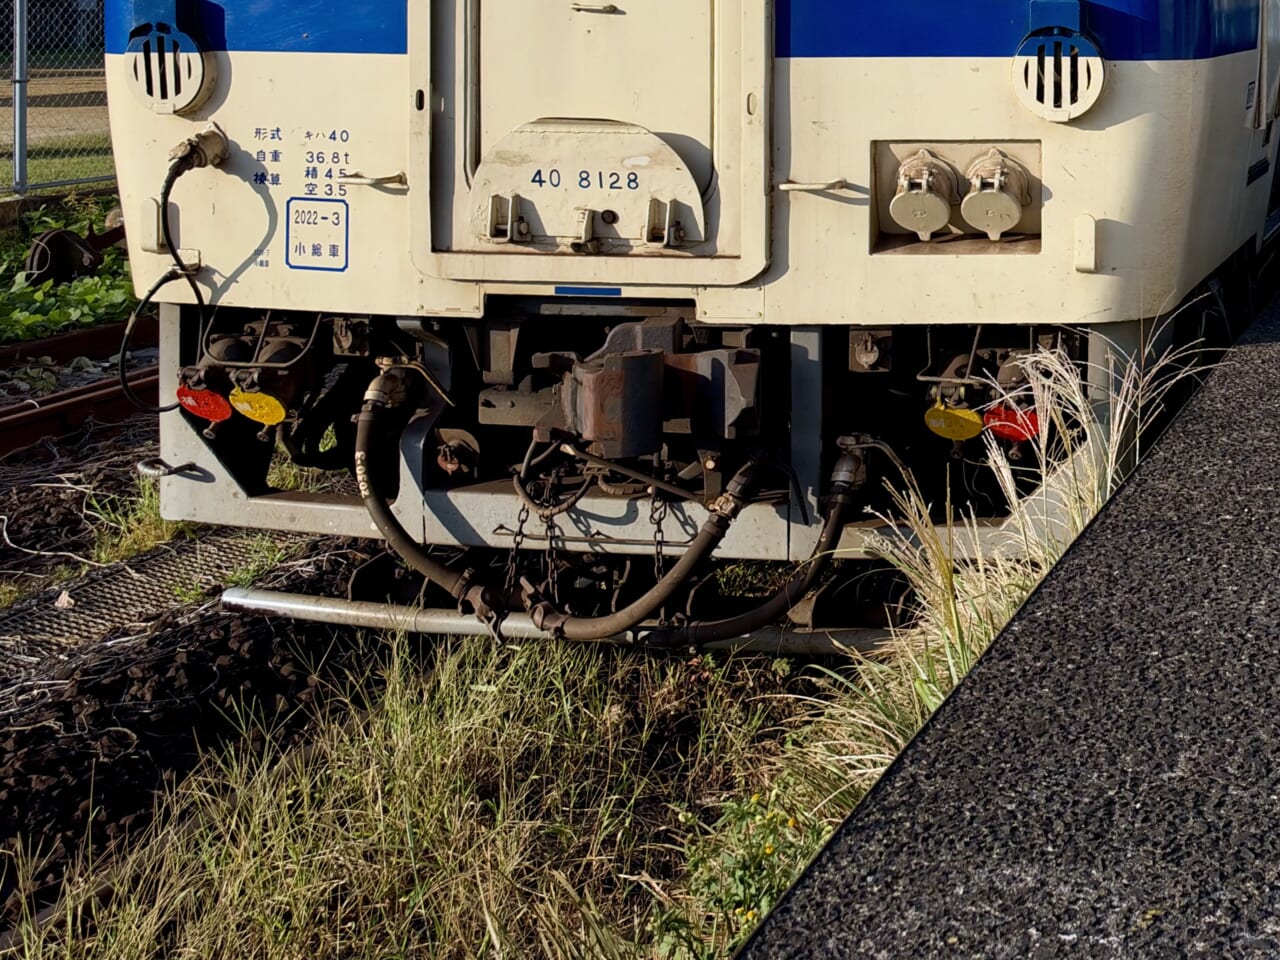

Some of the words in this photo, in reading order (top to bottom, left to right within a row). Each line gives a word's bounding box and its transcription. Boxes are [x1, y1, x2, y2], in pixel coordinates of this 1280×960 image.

[254, 127, 282, 141] 形式
[304, 130, 349, 142] キハ40
[256, 149, 283, 163] 自重
[530, 169, 561, 187] 40
[578, 170, 639, 189] 8128
